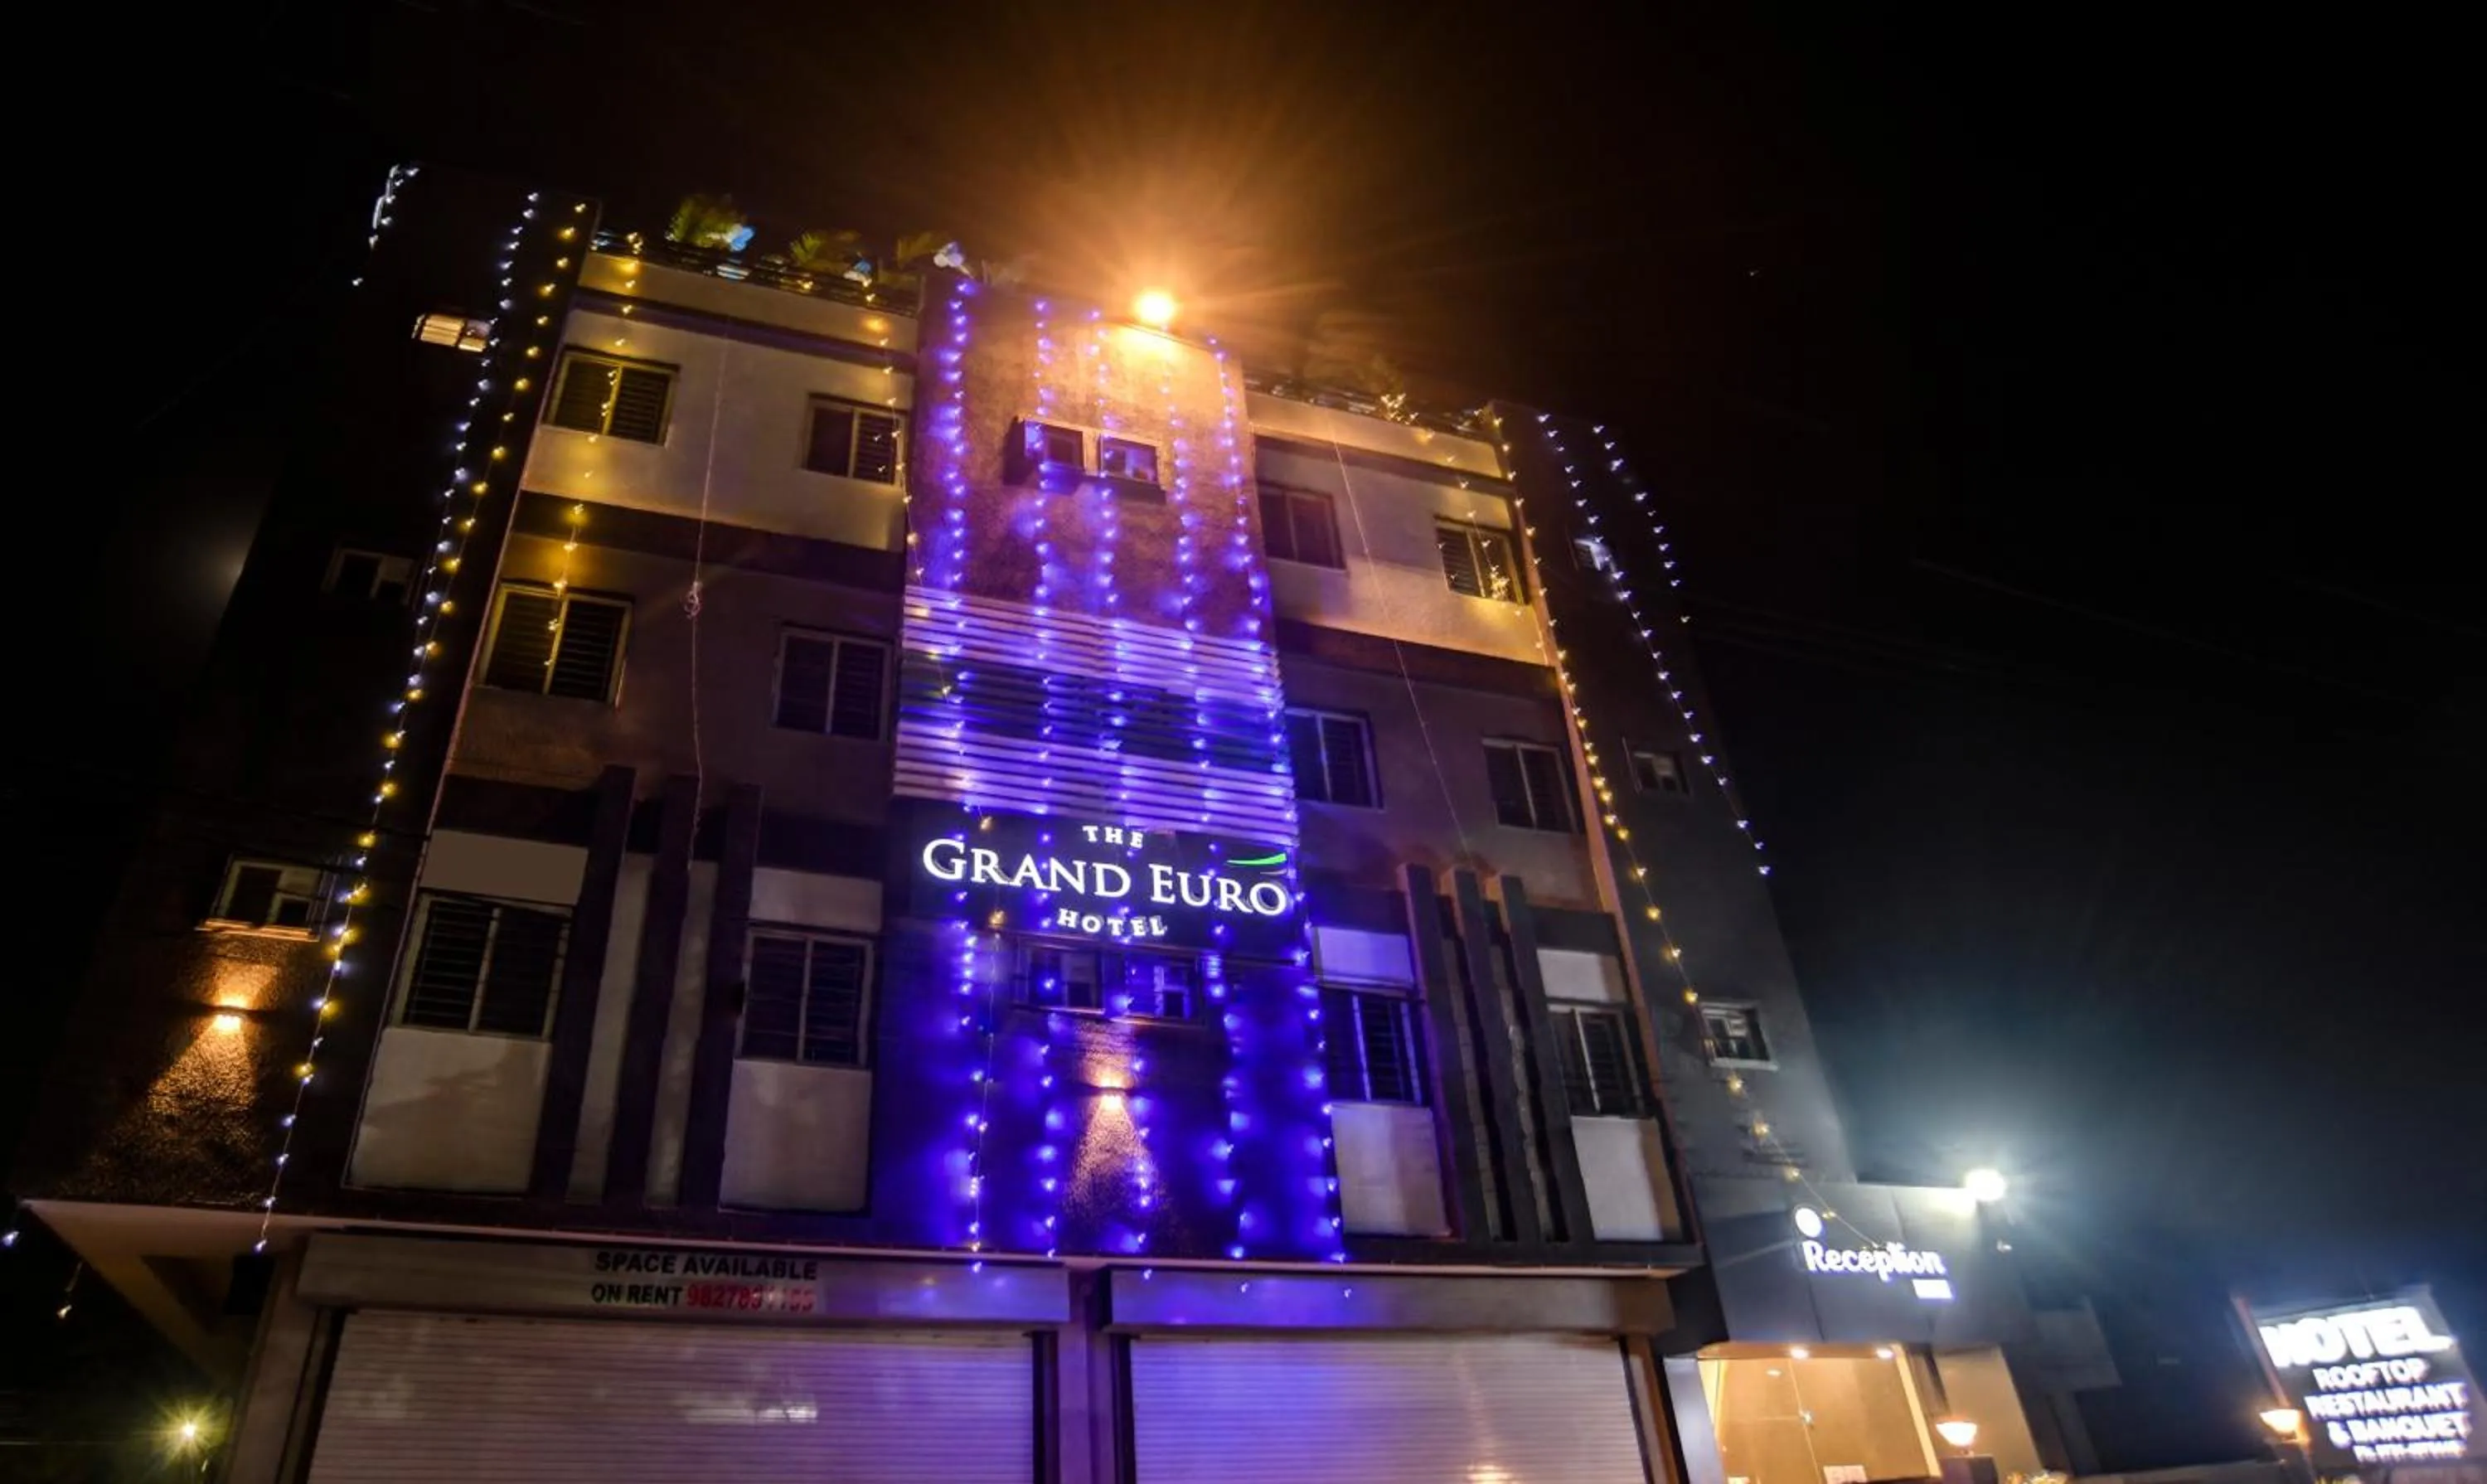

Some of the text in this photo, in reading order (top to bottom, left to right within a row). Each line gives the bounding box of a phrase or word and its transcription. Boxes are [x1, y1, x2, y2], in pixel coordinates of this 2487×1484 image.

[1083, 826, 1144, 848] THE
[923, 838, 1289, 915] GRAND EURO
[1058, 909, 1167, 936] HOTEL
[595, 1251, 817, 1280] SPACE AVAILABLE
[1802, 1240, 1946, 1283] Reception
[591, 1283, 621, 1304] ON
[626, 1285, 683, 1306] RENT
[2259, 1307, 2454, 1367] HOTEL
[2313, 1358, 2427, 1390] ROOFTOP
[2305, 1382, 2467, 1419] RESTAURANT
[2346, 1411, 2470, 1443] BANQUET
